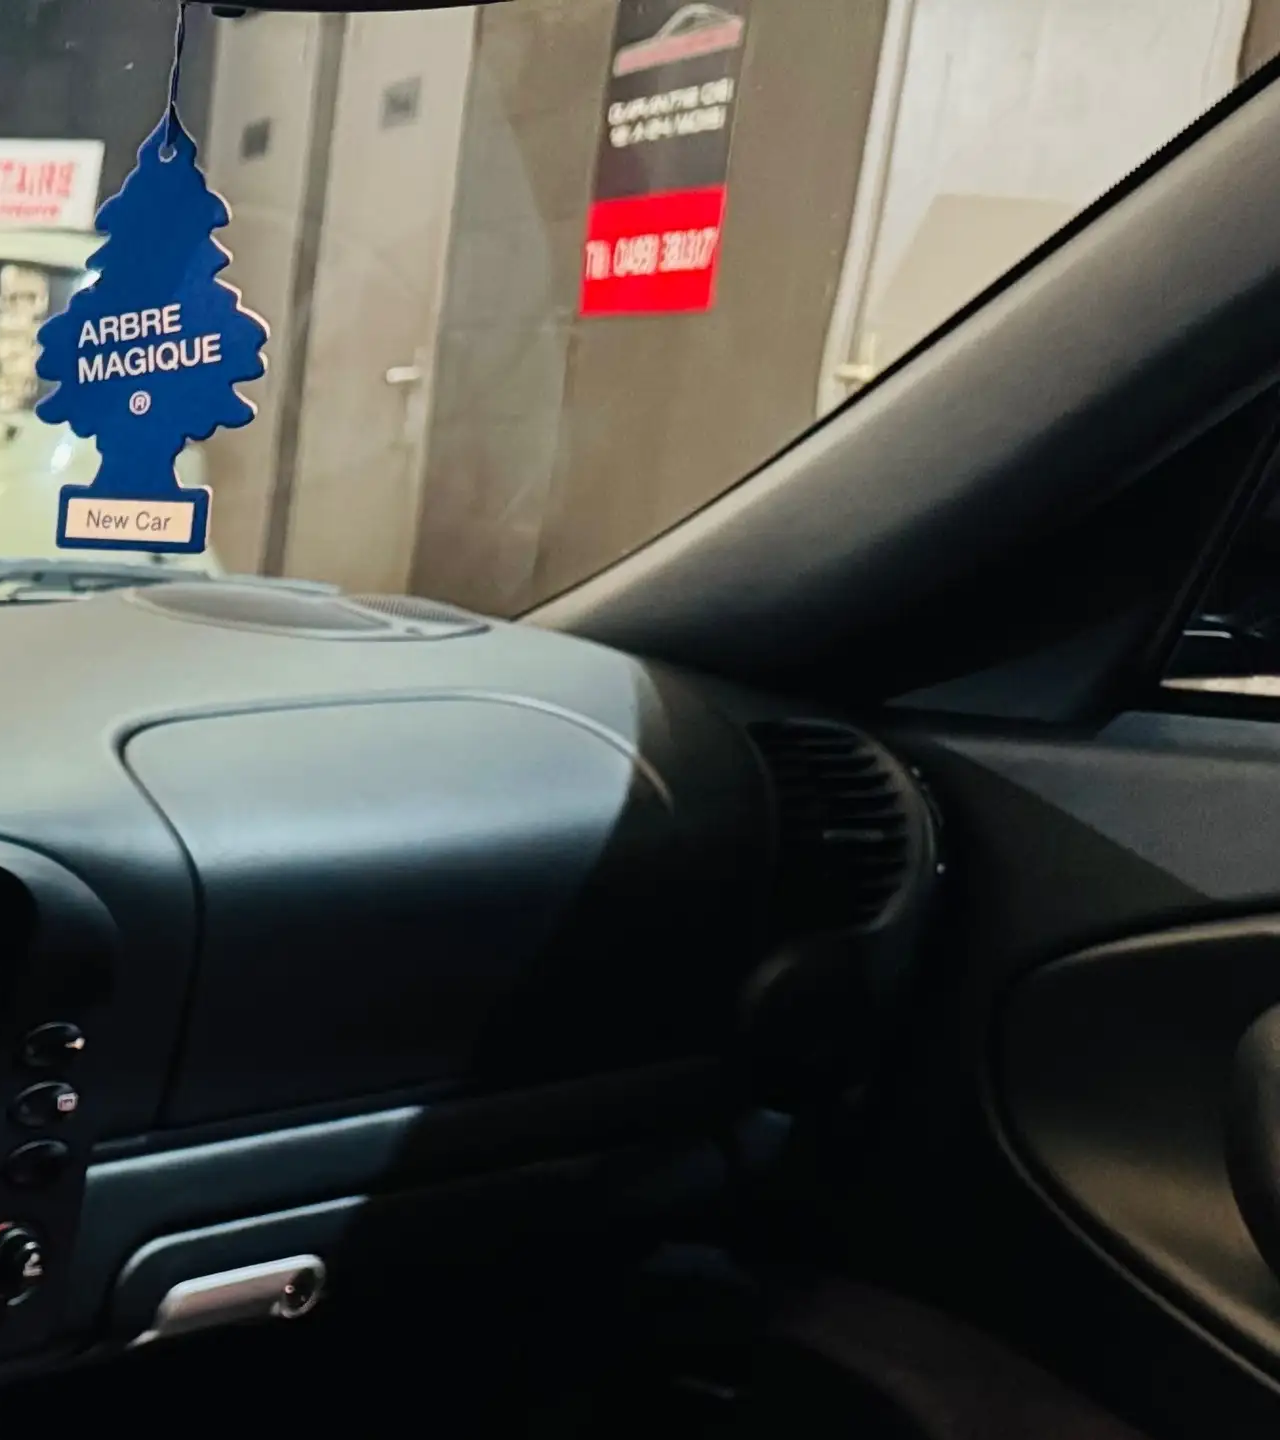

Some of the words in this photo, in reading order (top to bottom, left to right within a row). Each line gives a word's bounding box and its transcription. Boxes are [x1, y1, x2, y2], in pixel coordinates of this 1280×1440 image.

[78, 304, 182, 348] ARBRE
[78, 333, 222, 384] MAGIQUE
[86, 509, 130, 530] New
[135, 511, 172, 531] Car
